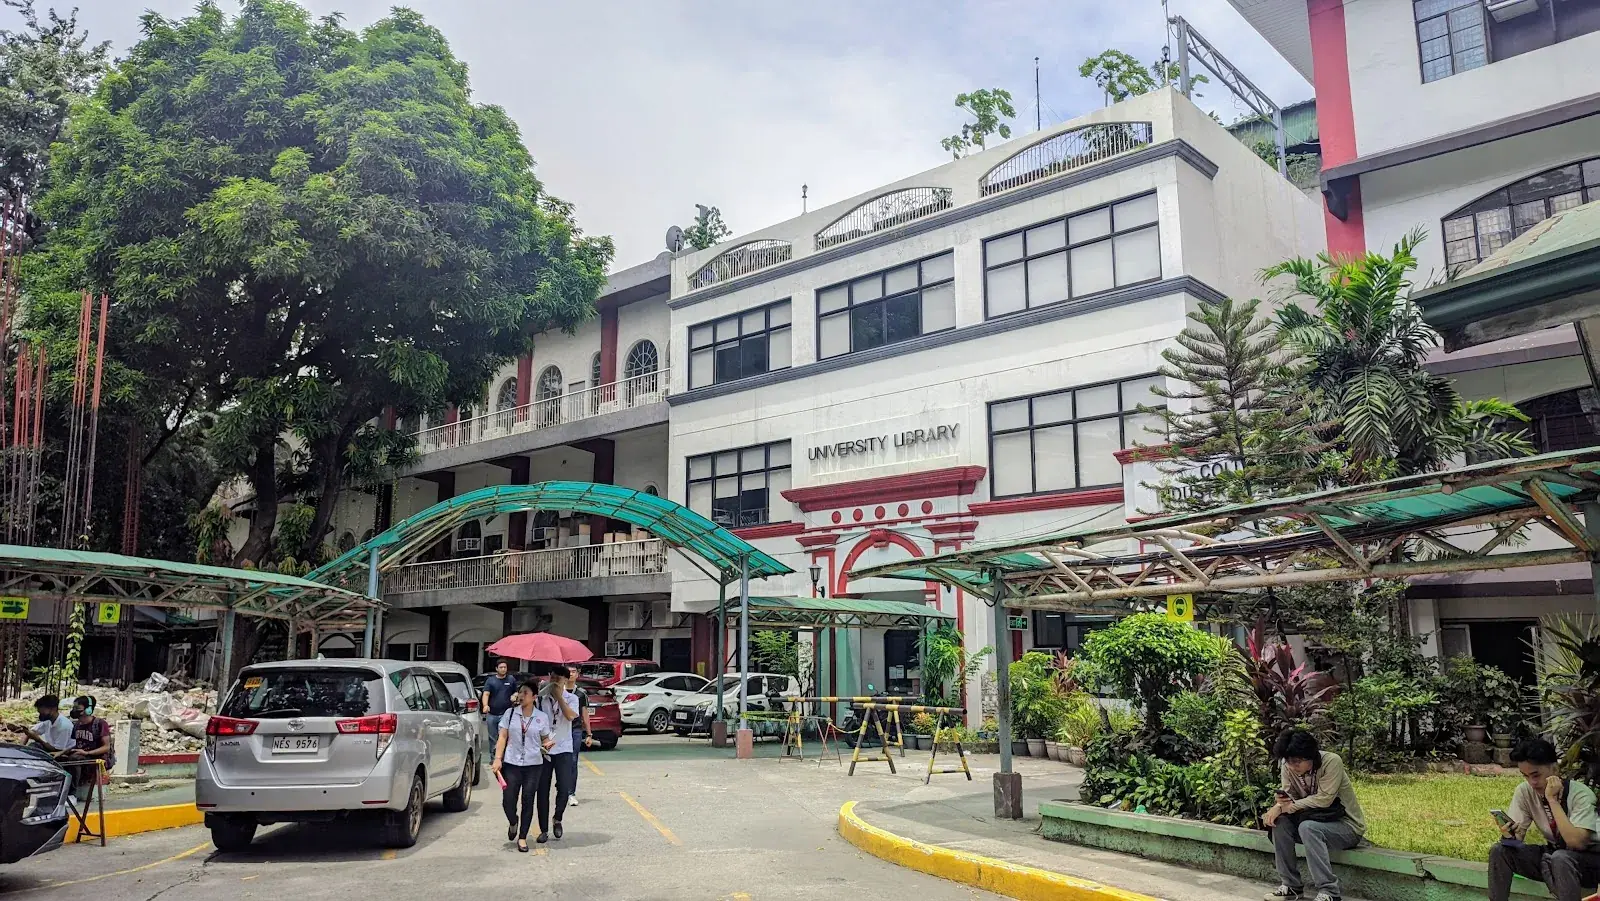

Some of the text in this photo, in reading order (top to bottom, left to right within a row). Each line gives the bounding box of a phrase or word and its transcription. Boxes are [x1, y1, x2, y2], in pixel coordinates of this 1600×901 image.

[808, 423, 960, 461] UNIVERSITY LIBRARY
[274, 740, 317, 749] NES 9576
